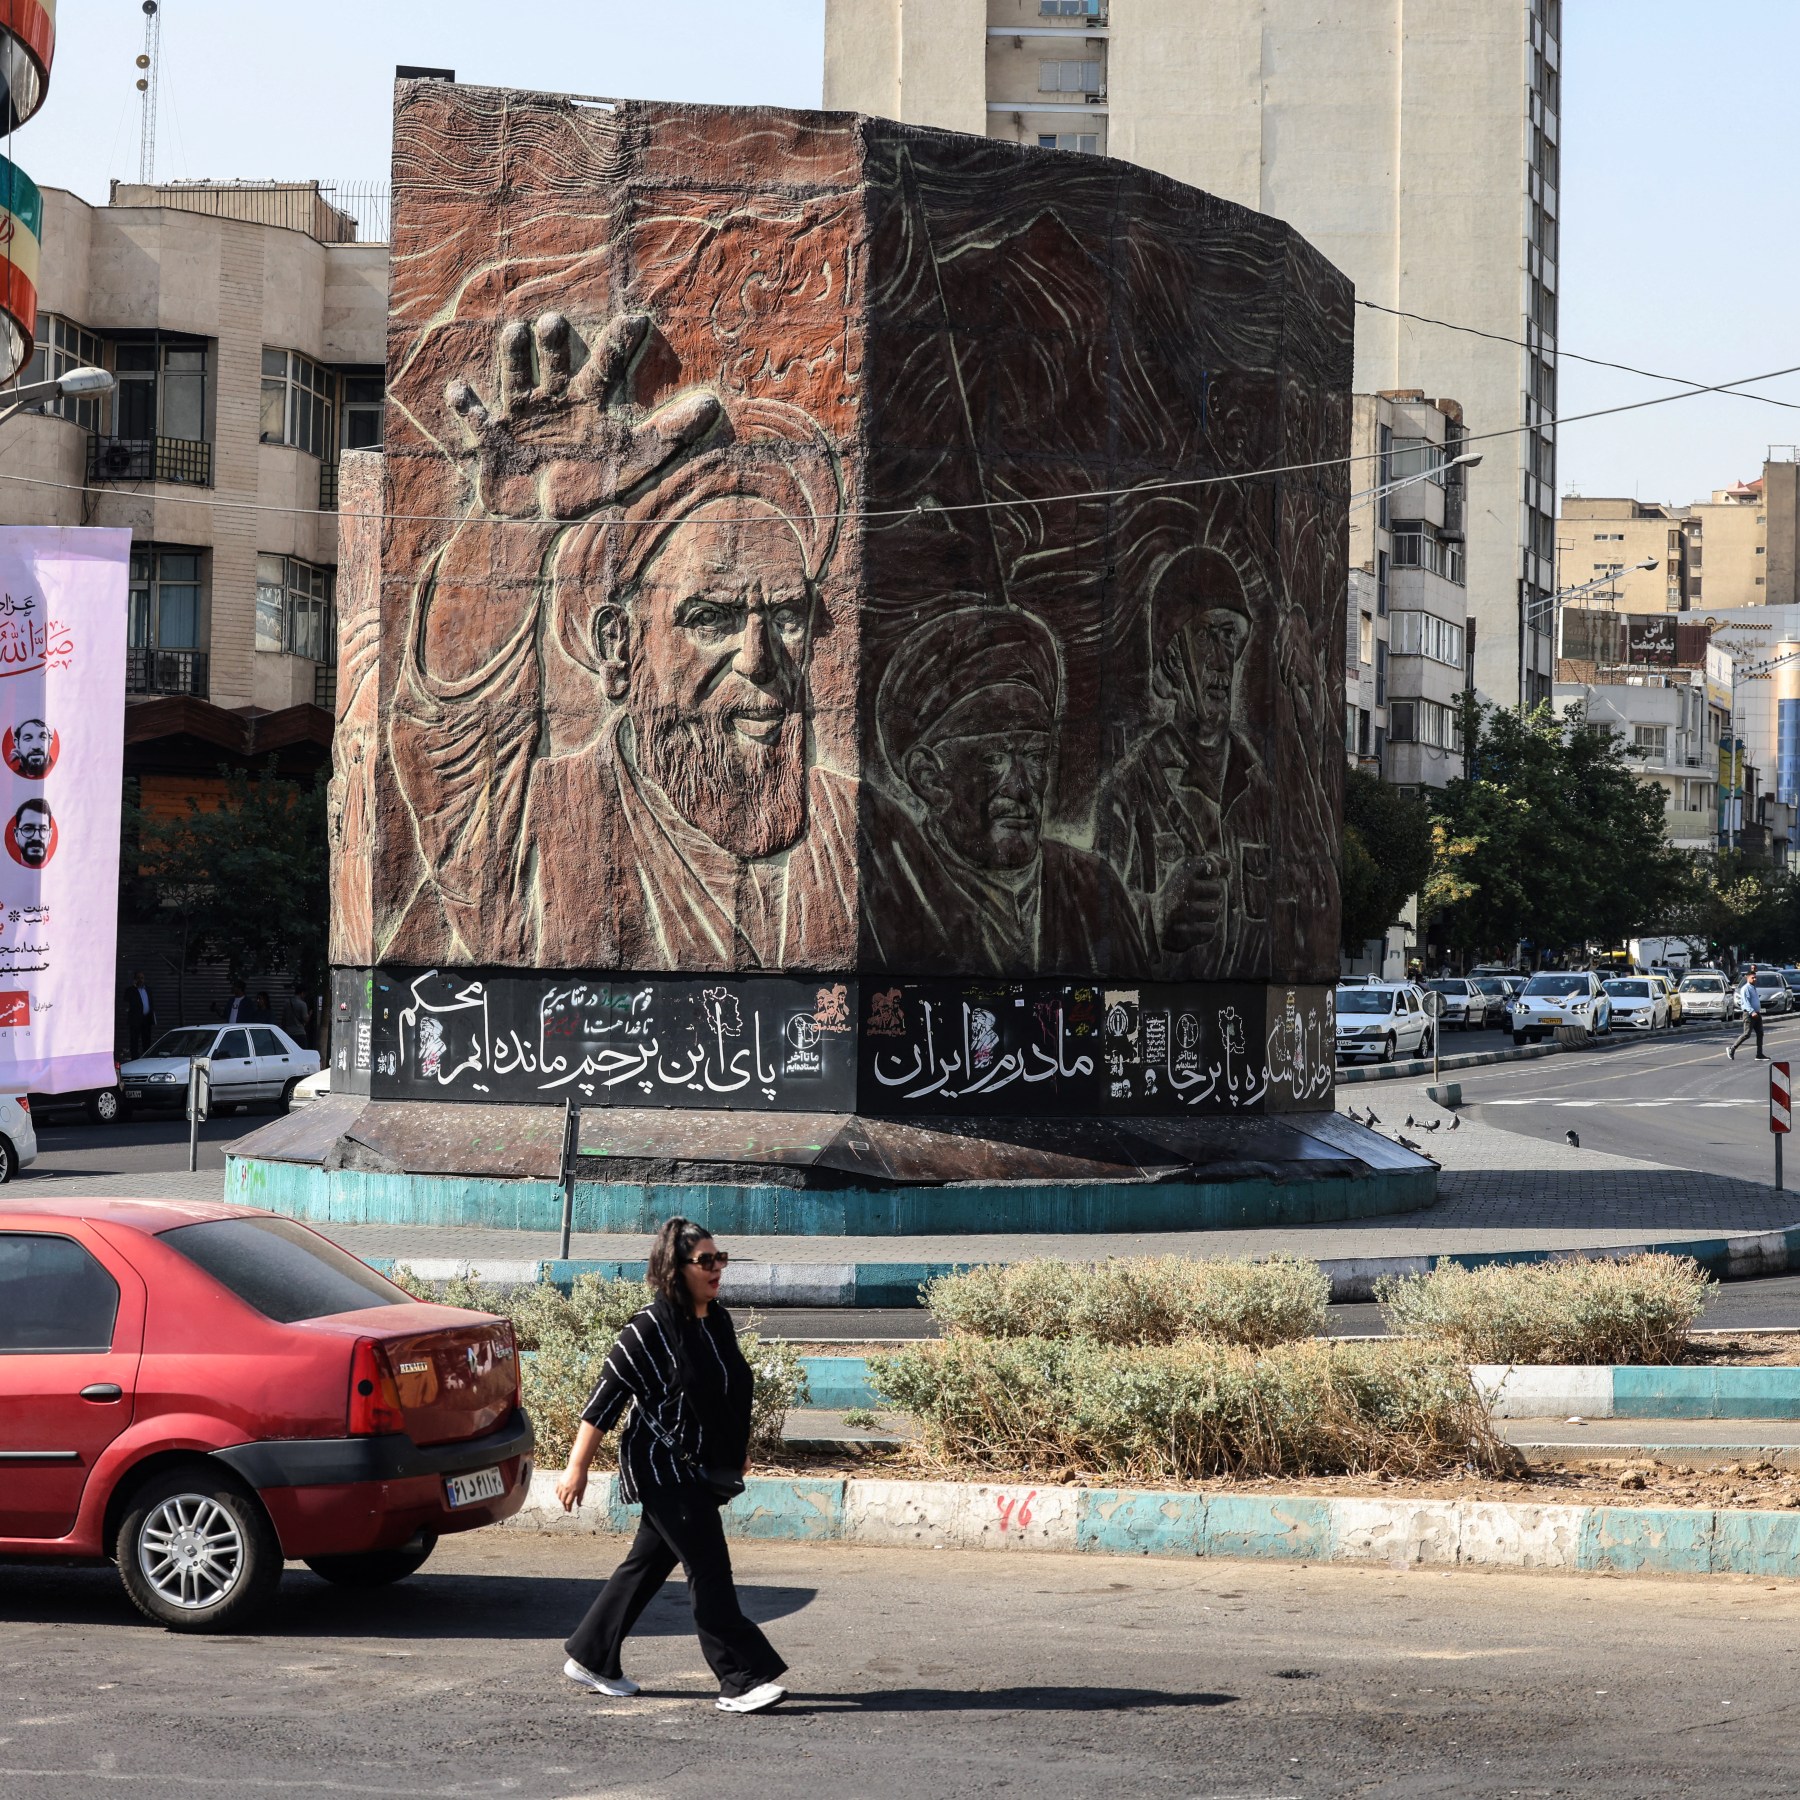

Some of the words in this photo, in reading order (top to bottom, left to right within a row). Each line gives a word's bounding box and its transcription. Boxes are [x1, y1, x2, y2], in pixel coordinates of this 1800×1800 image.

[1644, 618, 1664, 639] آش
[398, 969, 484, 1066] محکم
[786, 1050, 804, 1063] آخر
[810, 1053, 820, 1062] ما
[874, 1001, 971, 1099] ایران
